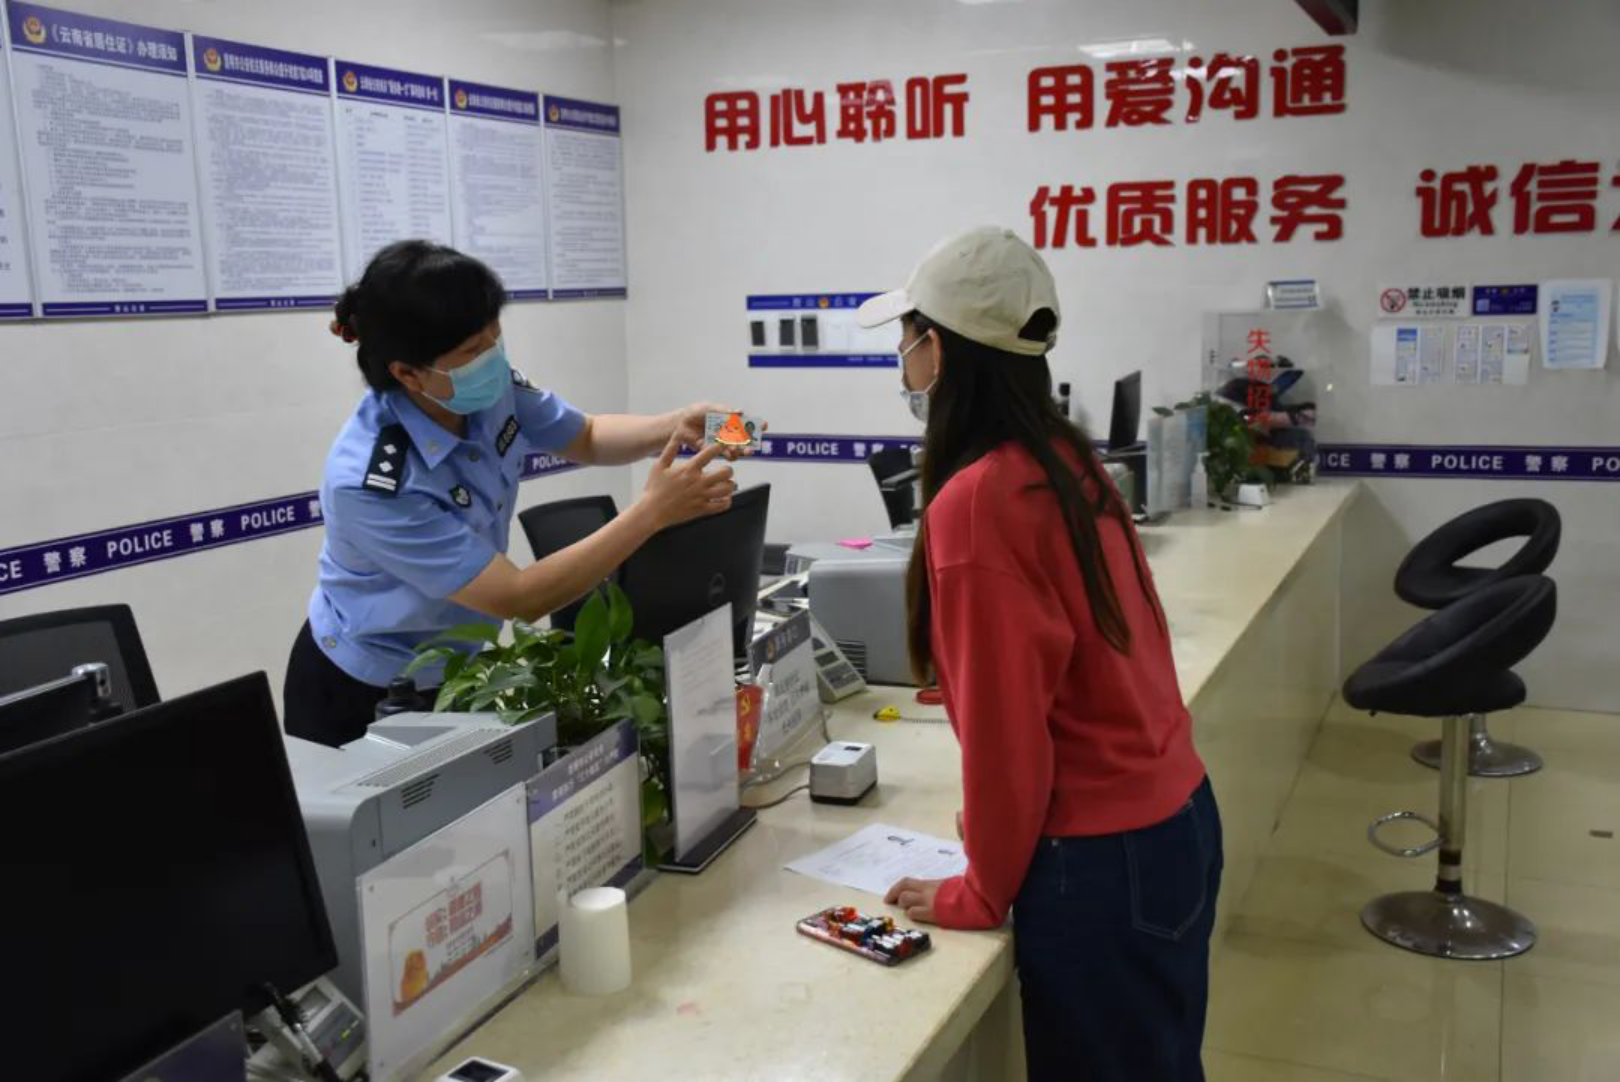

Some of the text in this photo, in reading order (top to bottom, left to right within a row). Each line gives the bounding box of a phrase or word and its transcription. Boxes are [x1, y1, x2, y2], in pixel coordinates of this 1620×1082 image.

[704, 45, 1347, 151] 用心聆听 用爱沟通
[1030, 174, 1347, 249] 优质服务
[786, 442, 840, 456] POLICE
[1370, 453, 1410, 469] 警察
[1430, 454, 1504, 470] POLICE
[1525, 454, 1569, 472] 警察
[43, 545, 88, 575] 警察
[106, 529, 174, 559] POLICE
[189, 518, 225, 543] 警察
[240, 505, 296, 531] POLICE
